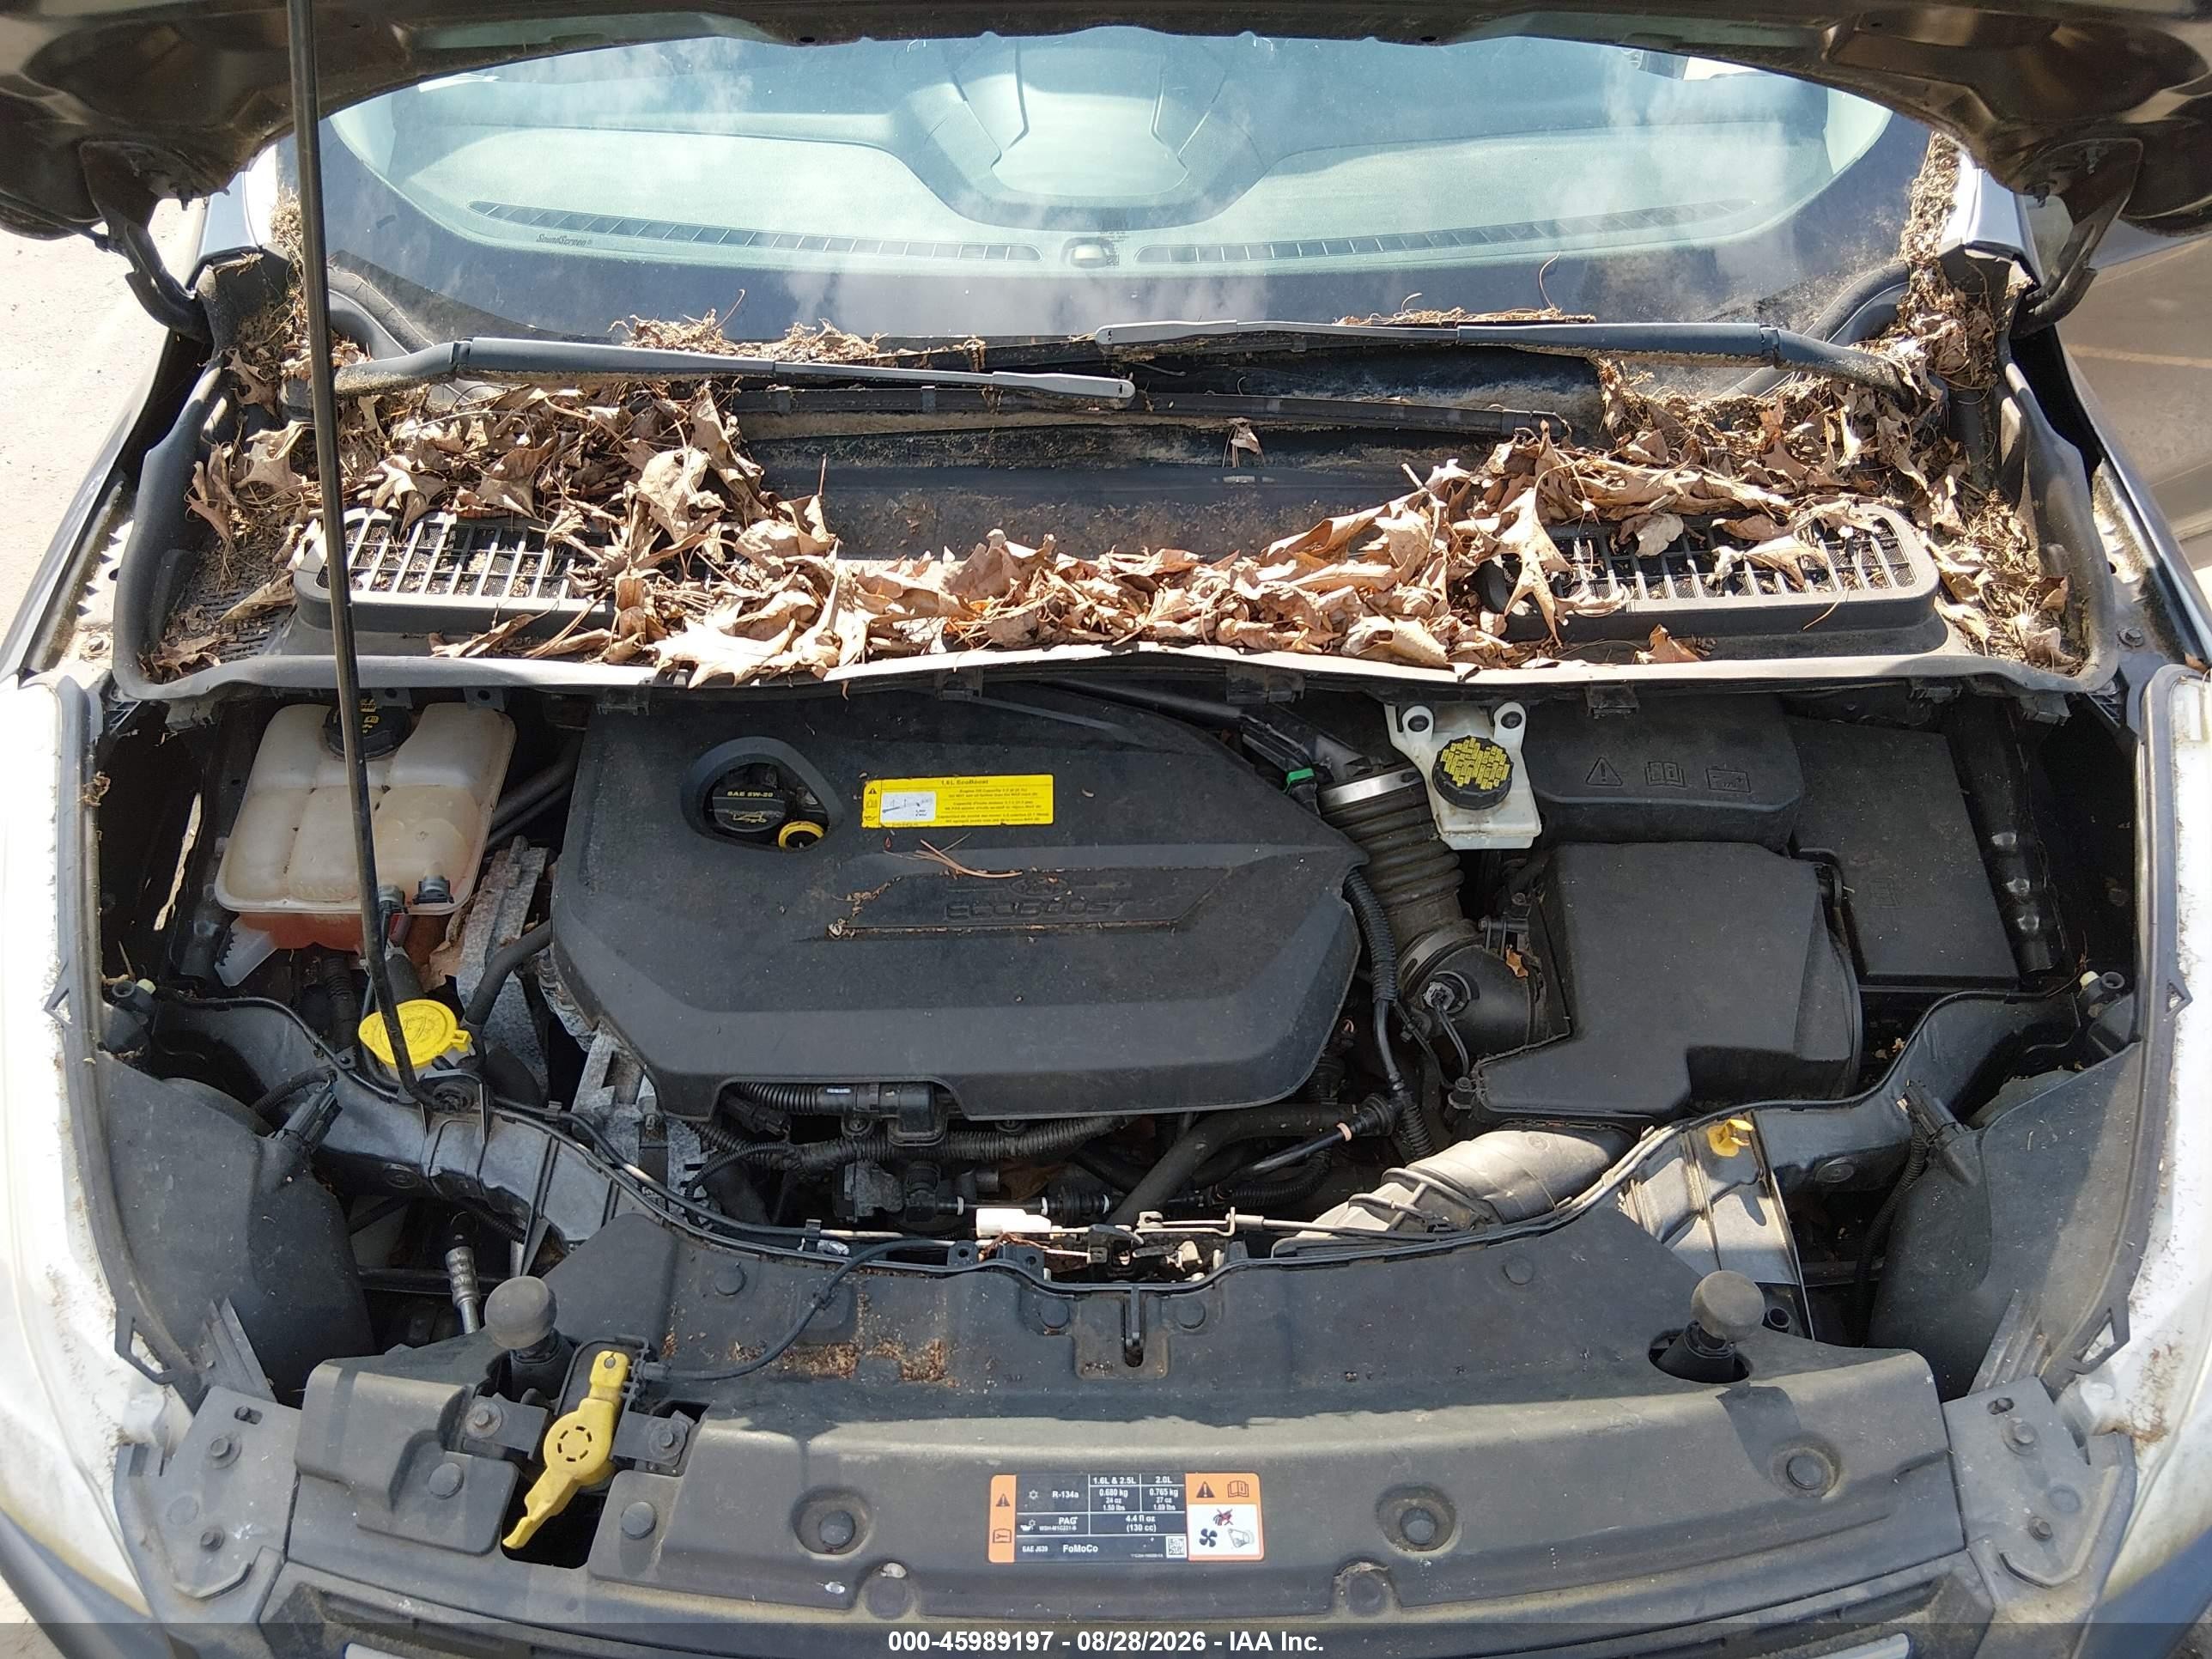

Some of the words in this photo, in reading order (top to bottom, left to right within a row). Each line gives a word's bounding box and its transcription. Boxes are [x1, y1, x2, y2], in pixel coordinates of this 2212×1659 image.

[1093, 1476, 1109, 1485] 1.6L
[1155, 1475, 1173, 1484] 2.0L
[1118, 1488, 1128, 1498] kg
[1169, 1487, 1179, 1498] kg
[1126, 1523, 1143, 1533] (130
[1144, 1523, 1158, 1533] cc)
[1062, 1544, 1099, 1553] FoMoCo
